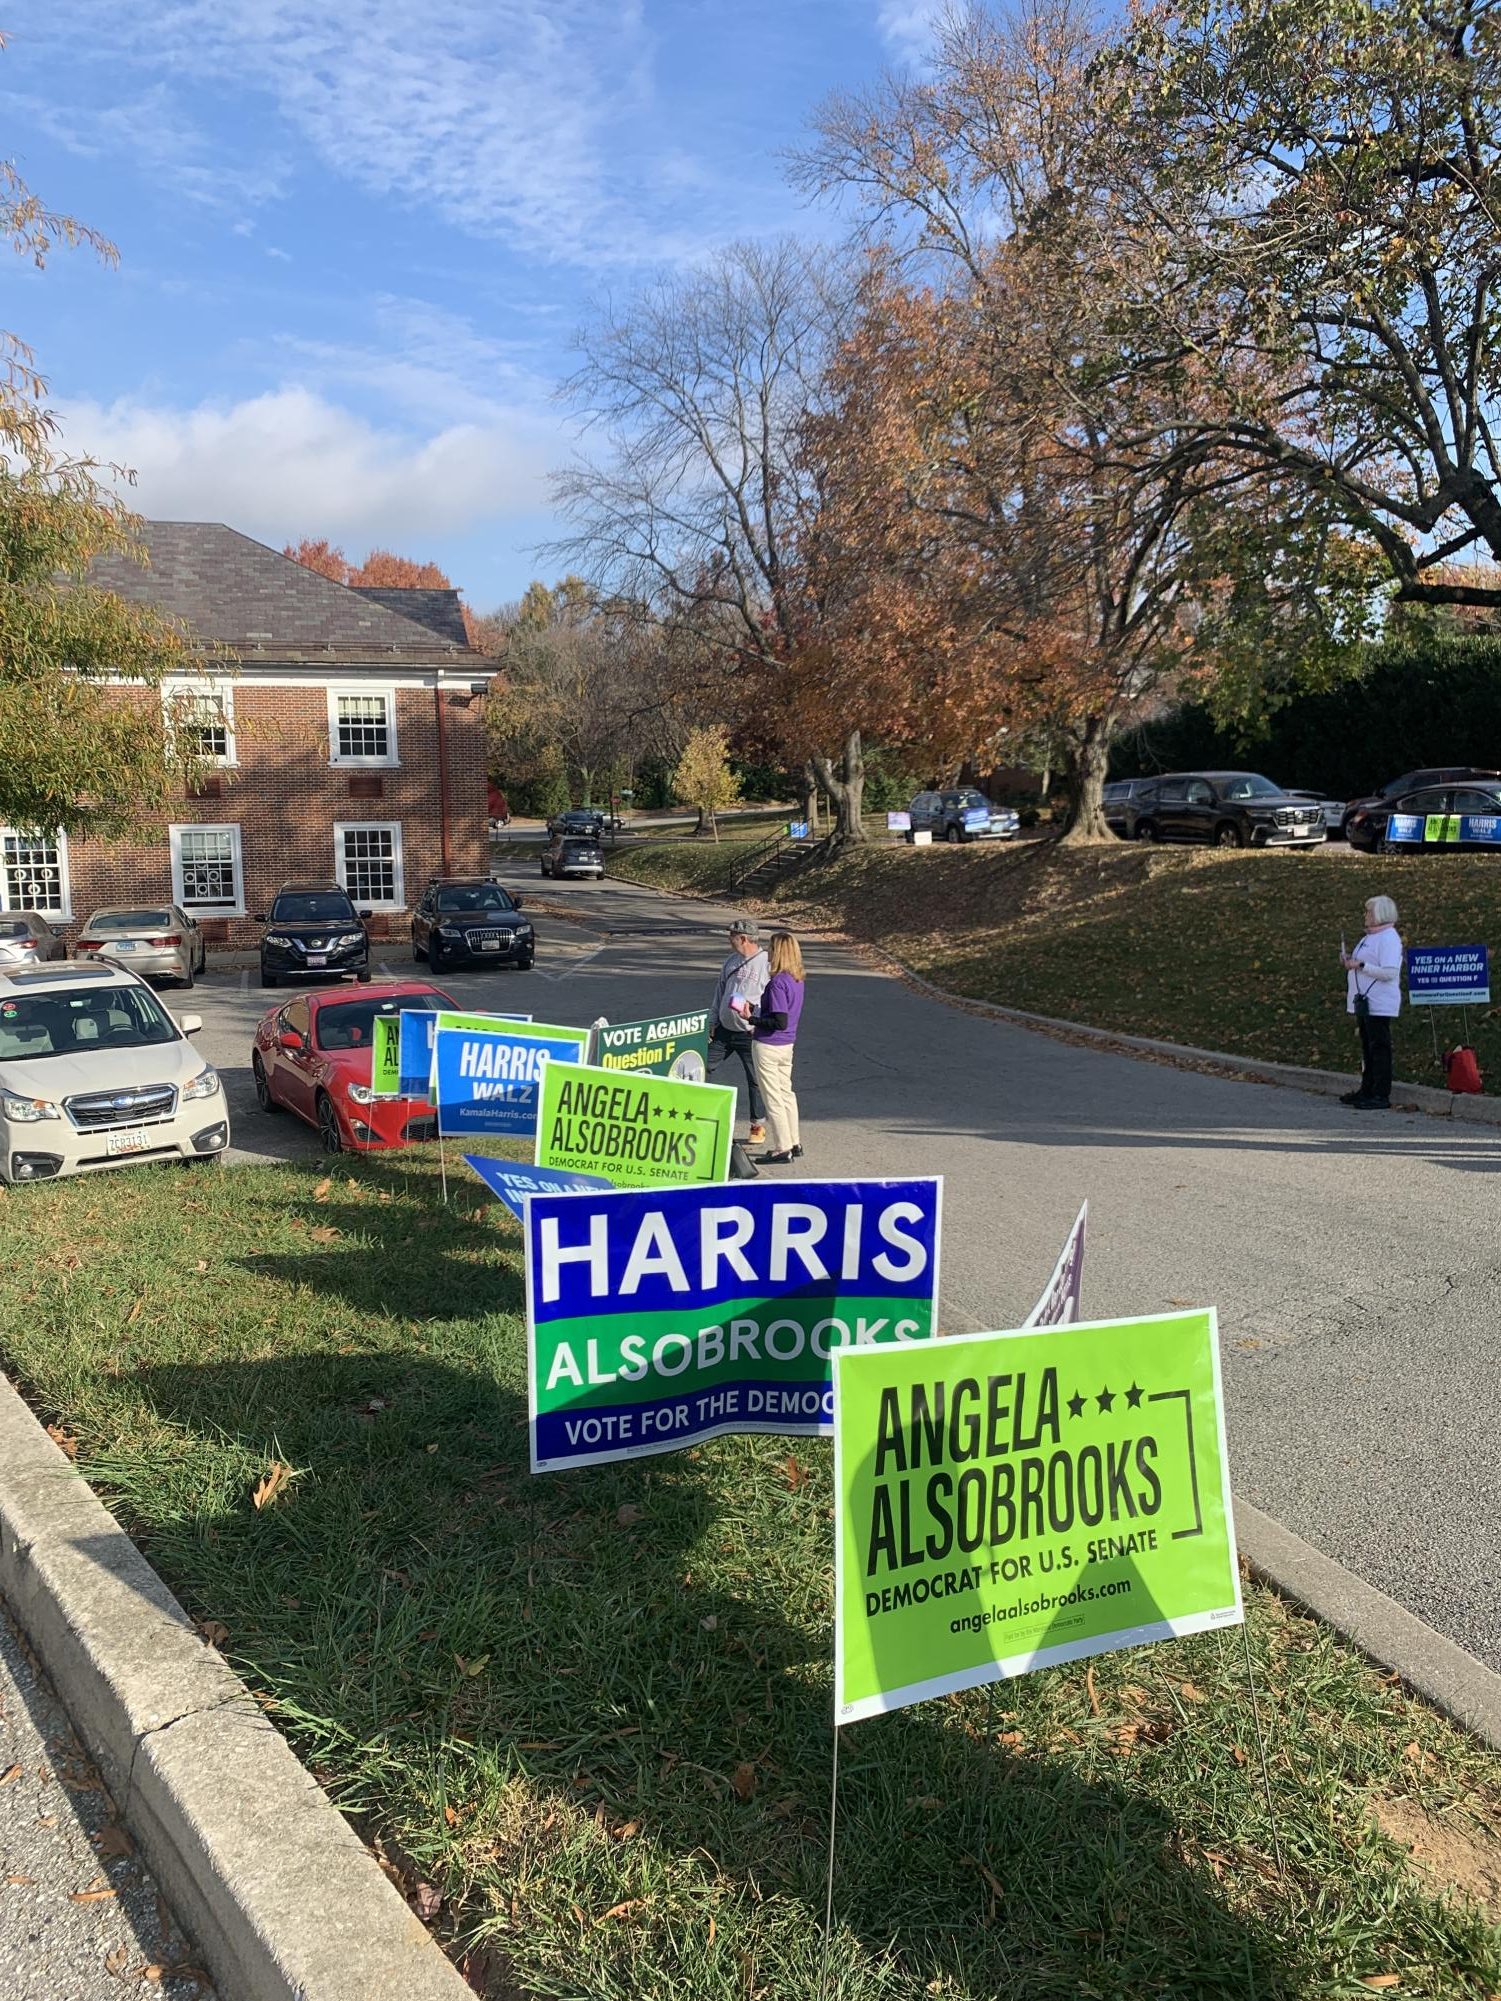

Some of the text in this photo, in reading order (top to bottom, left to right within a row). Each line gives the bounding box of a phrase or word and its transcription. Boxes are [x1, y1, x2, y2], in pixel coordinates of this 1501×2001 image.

[1411, 962, 1484, 974] INNER HARBOR
[1415, 956, 1433, 964] YES
[1455, 953, 1479, 963] NEW
[1439, 975, 1472, 983] QUESTION
[603, 1014, 708, 1047] VOTE AGAINST
[460, 1041, 550, 1081] HARRIS
[602, 1041, 676, 1070] Question F
[472, 1081, 532, 1104] WALZ
[557, 1081, 650, 1125] ANGELA
[550, 1117, 698, 1167] ALSOBROOKS
[496, 1172, 539, 1191] YES
[548, 1157, 689, 1181] DEMOCRAT FOR U.S. SENATE
[540, 1202, 927, 1303] HARRIS
[545, 1317, 921, 1390] ALSOBROOKS
[565, 1415, 633, 1446] VOTE
[641, 1405, 690, 1435] FOR
[696, 1390, 739, 1421] THE
[748, 1390, 834, 1414] DEMOC
[874, 1366, 1061, 1477] ANGELA
[867, 1435, 1162, 1577] ALSOBROOKS
[865, 1529, 1158, 1617] DEMOCRAT FOR U.S. SENATE
[950, 1578, 1131, 1634] angelaalsobrooks.com
